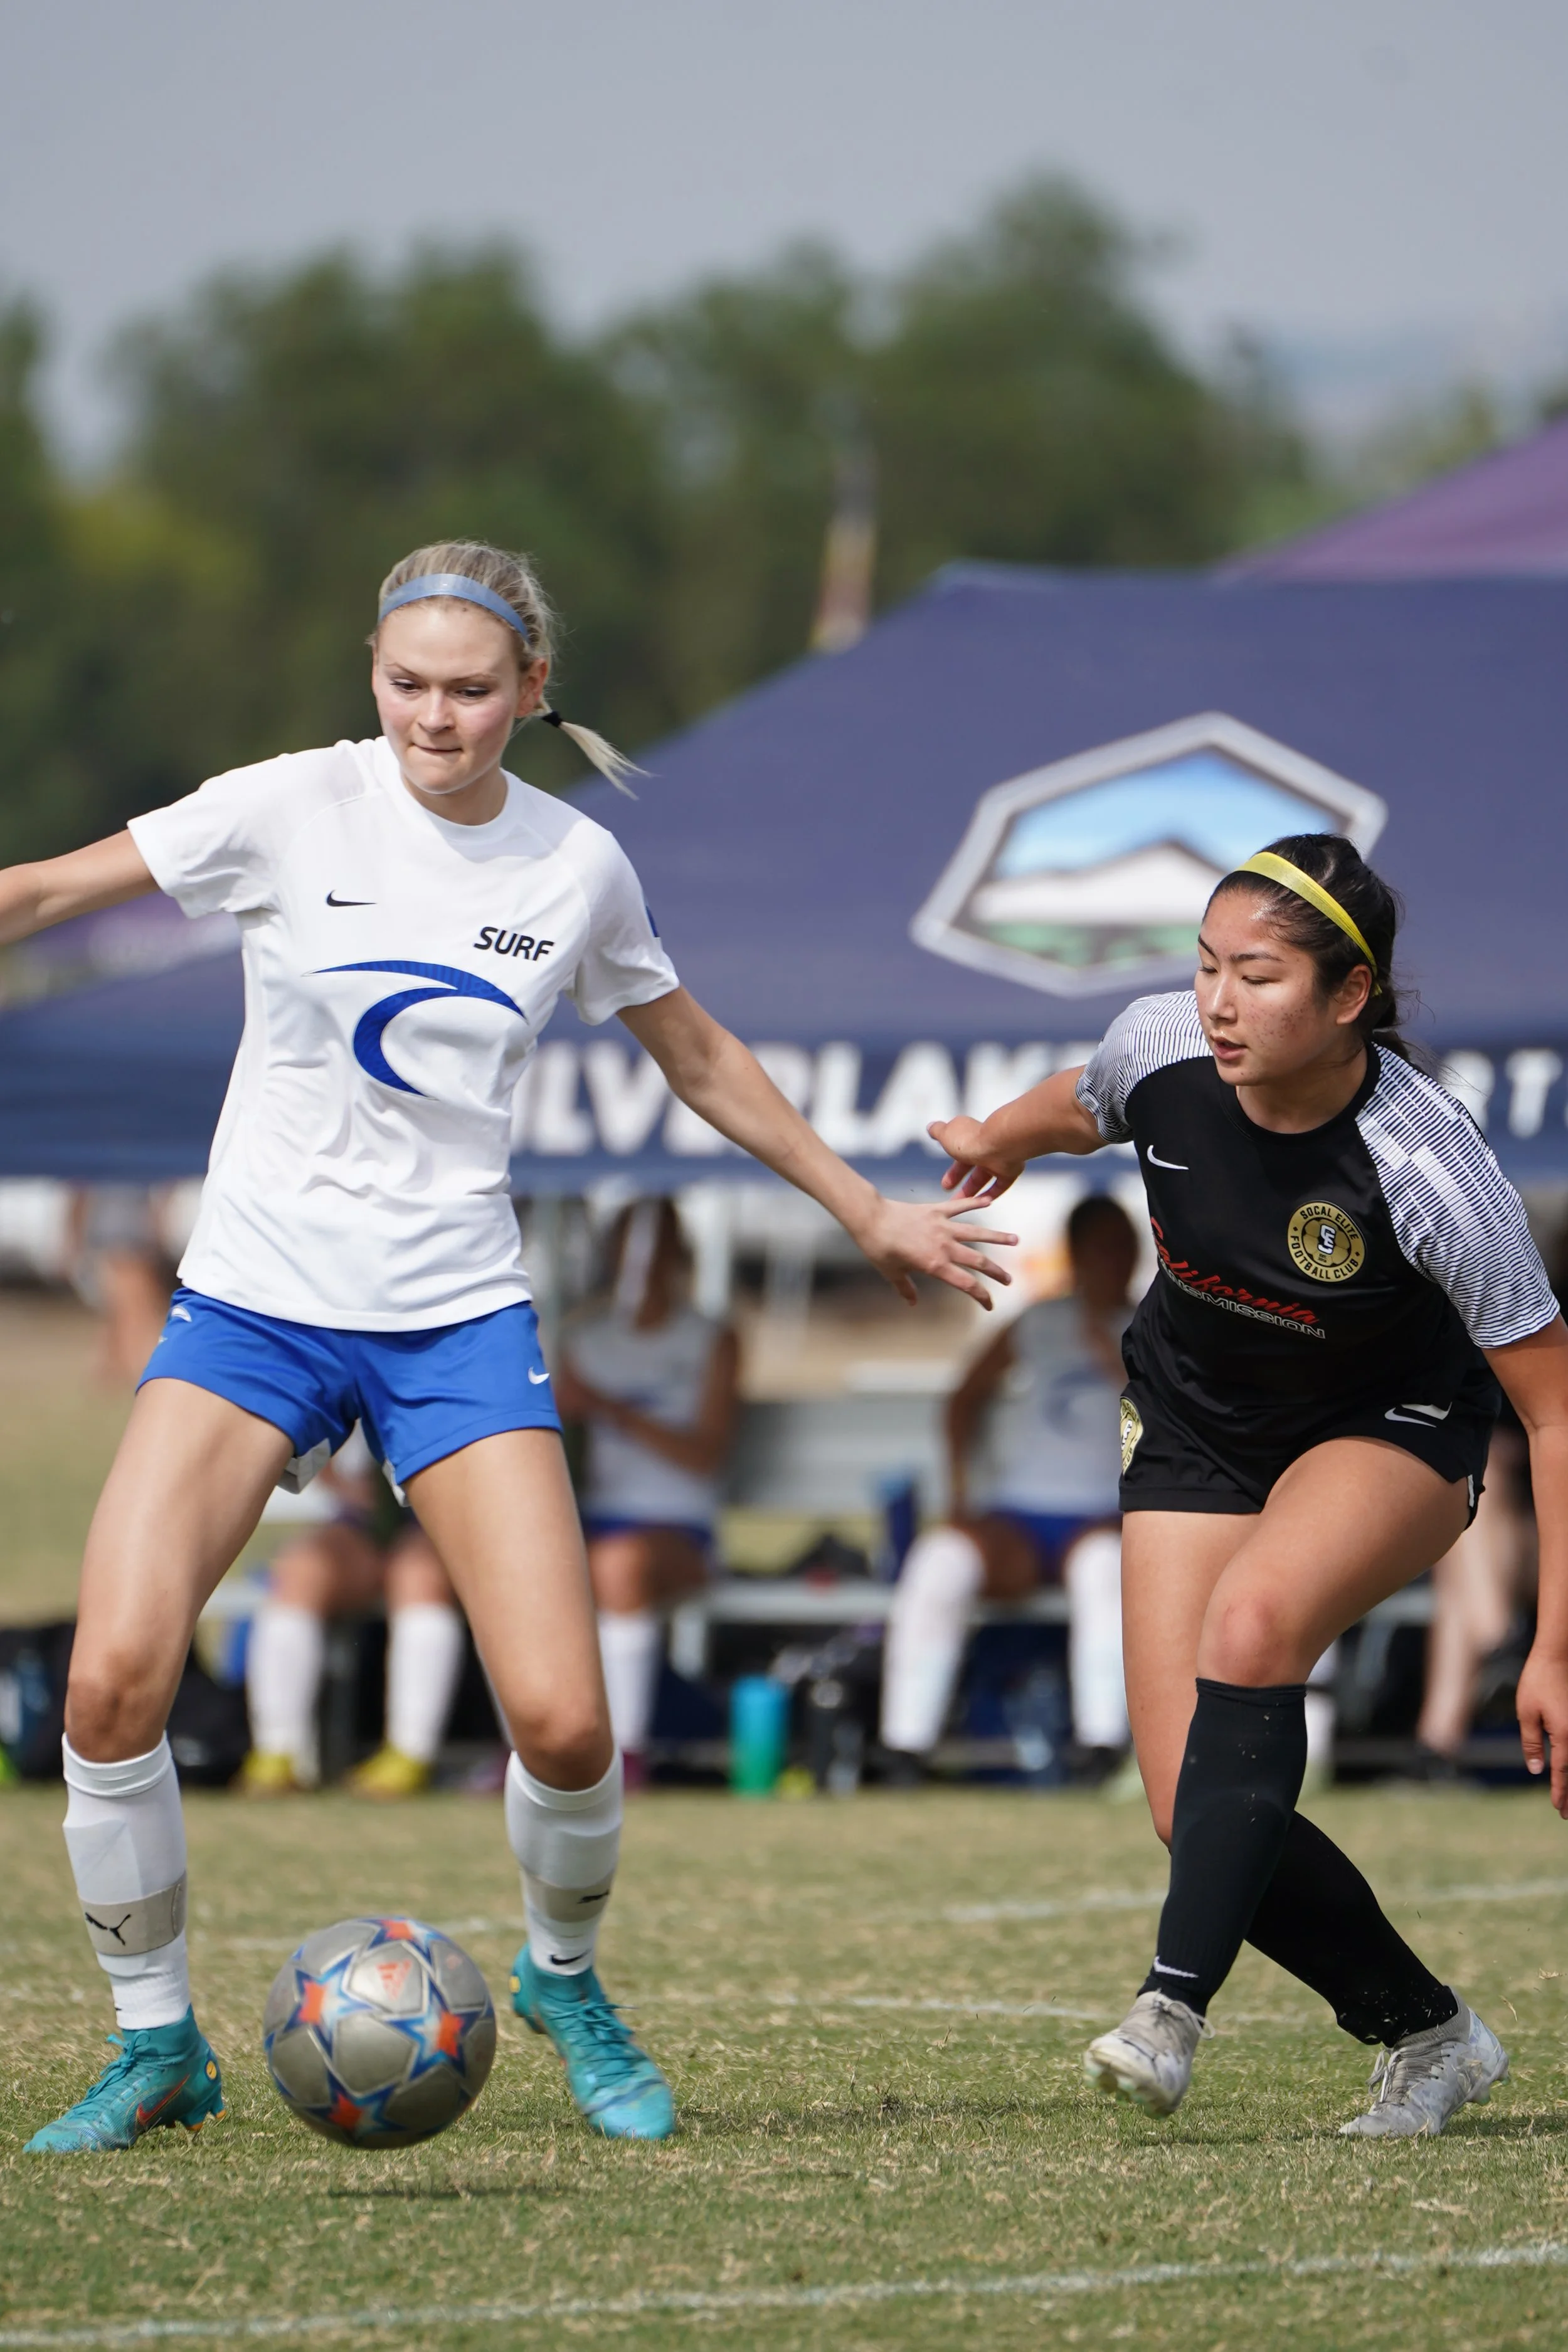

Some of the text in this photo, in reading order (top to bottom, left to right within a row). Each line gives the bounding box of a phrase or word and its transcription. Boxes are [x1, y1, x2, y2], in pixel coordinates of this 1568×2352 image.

[474, 926, 554, 961] SURF
[1300, 1205, 1359, 1240] SOCAL ELITE
[1290, 1235, 1359, 1279] FOOTBALL CLUB
